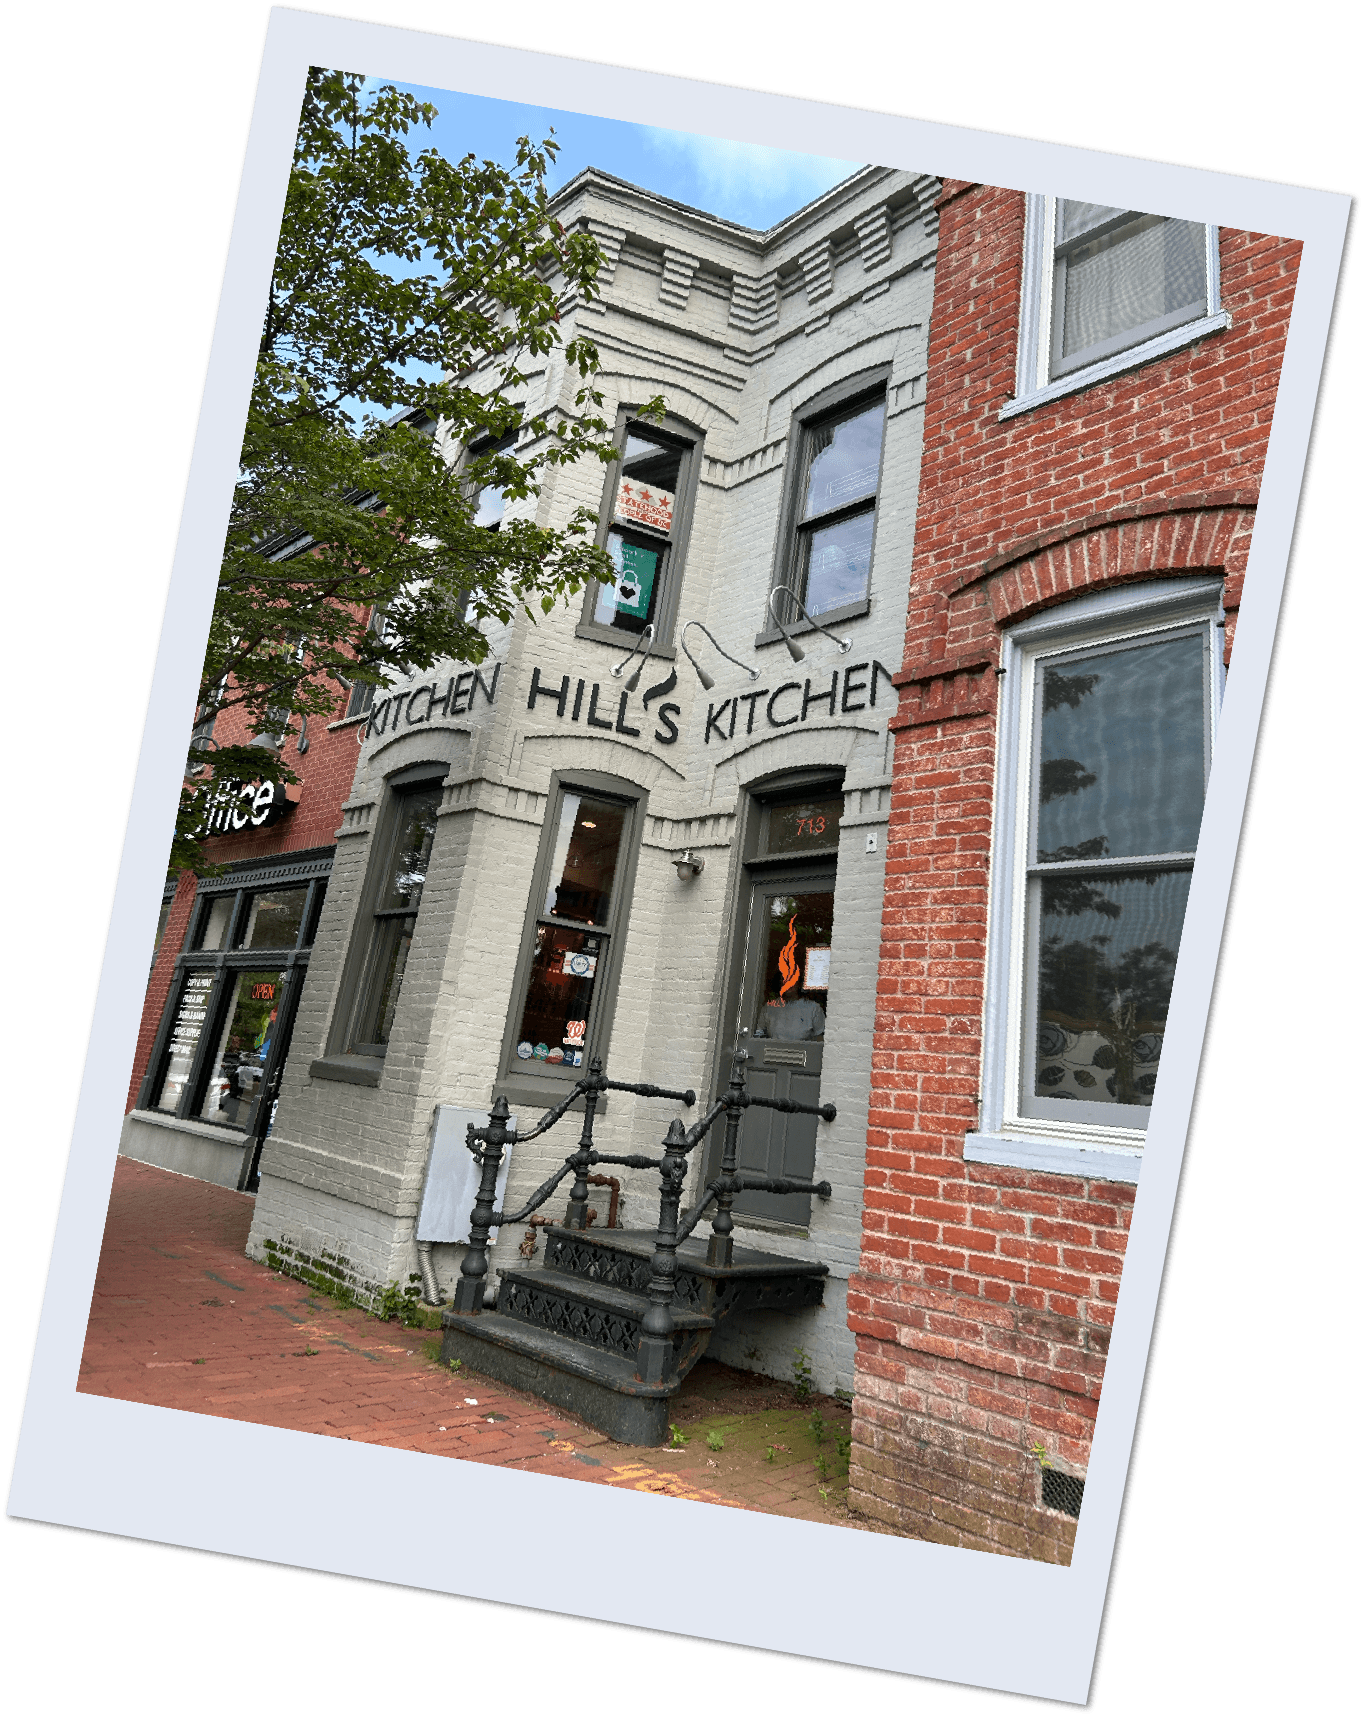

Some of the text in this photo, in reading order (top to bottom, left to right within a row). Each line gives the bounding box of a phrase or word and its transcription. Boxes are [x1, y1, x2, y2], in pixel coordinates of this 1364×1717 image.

[364, 661, 501, 738] KITCHEN
[527, 665, 680, 745] HILL'S
[796, 816, 825, 836] 713
[252, 983, 276, 999] OPEN
